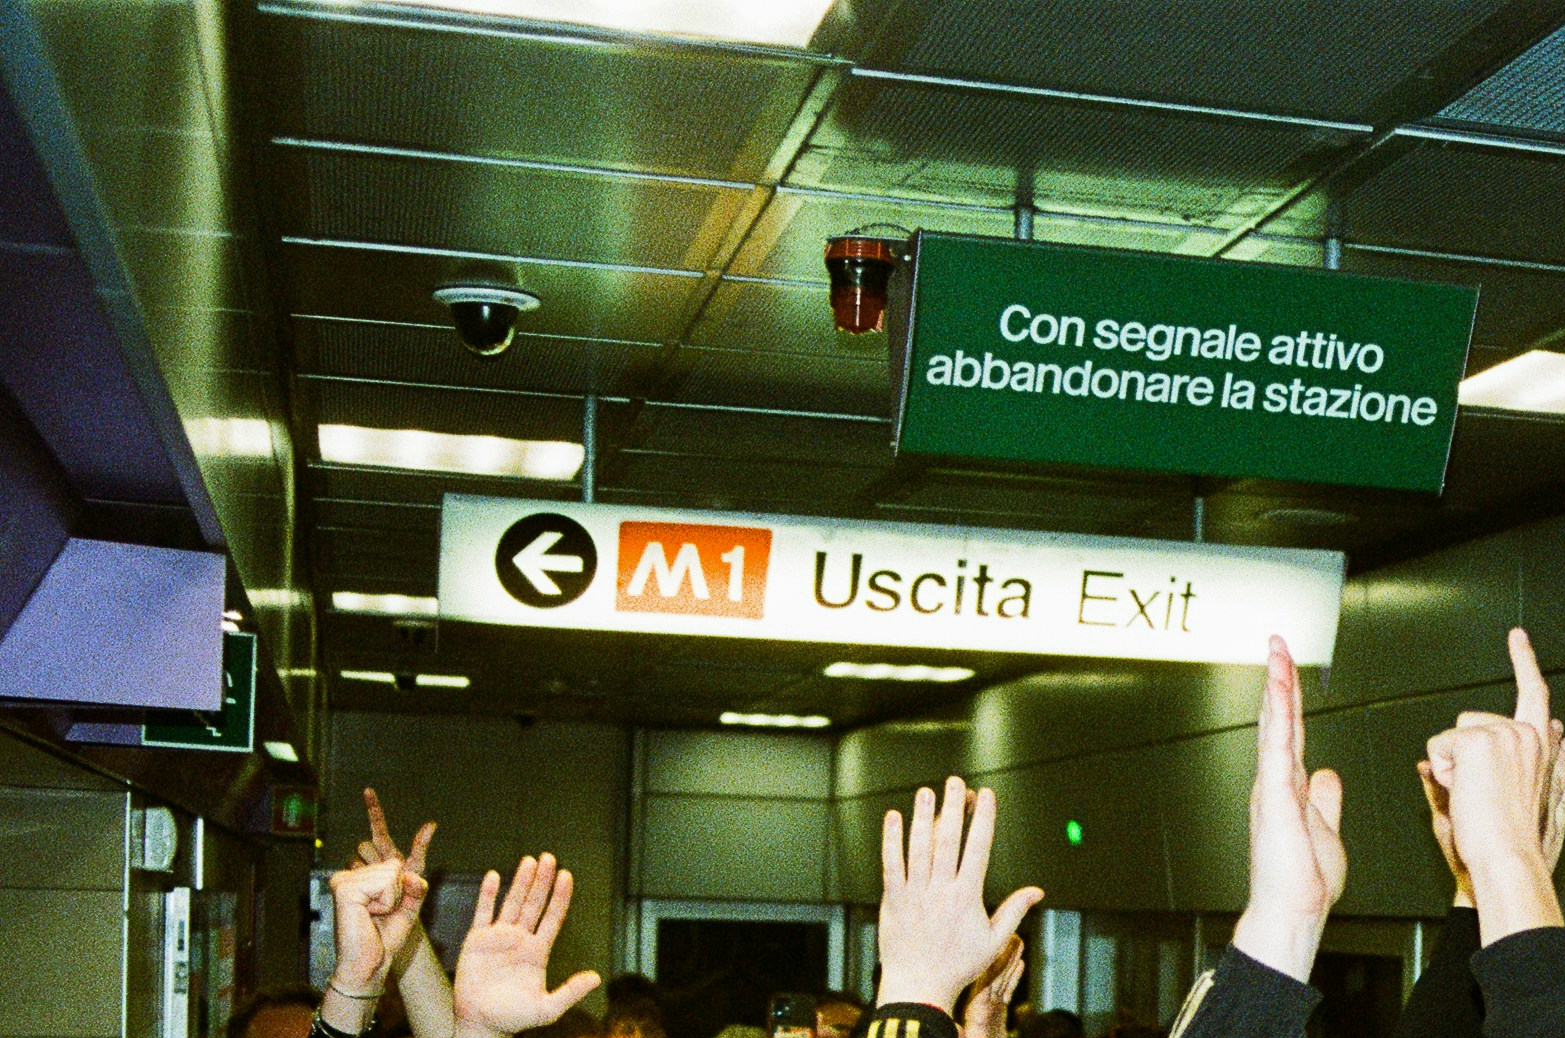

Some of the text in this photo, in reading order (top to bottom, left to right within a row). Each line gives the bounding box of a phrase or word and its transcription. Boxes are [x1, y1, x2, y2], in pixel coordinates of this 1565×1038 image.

[999, 303, 1385, 374] Con segnale attivo
[925, 350, 1438, 427] abbandonare la stazione
[626, 540, 1198, 633] M1 Uscita Exit
